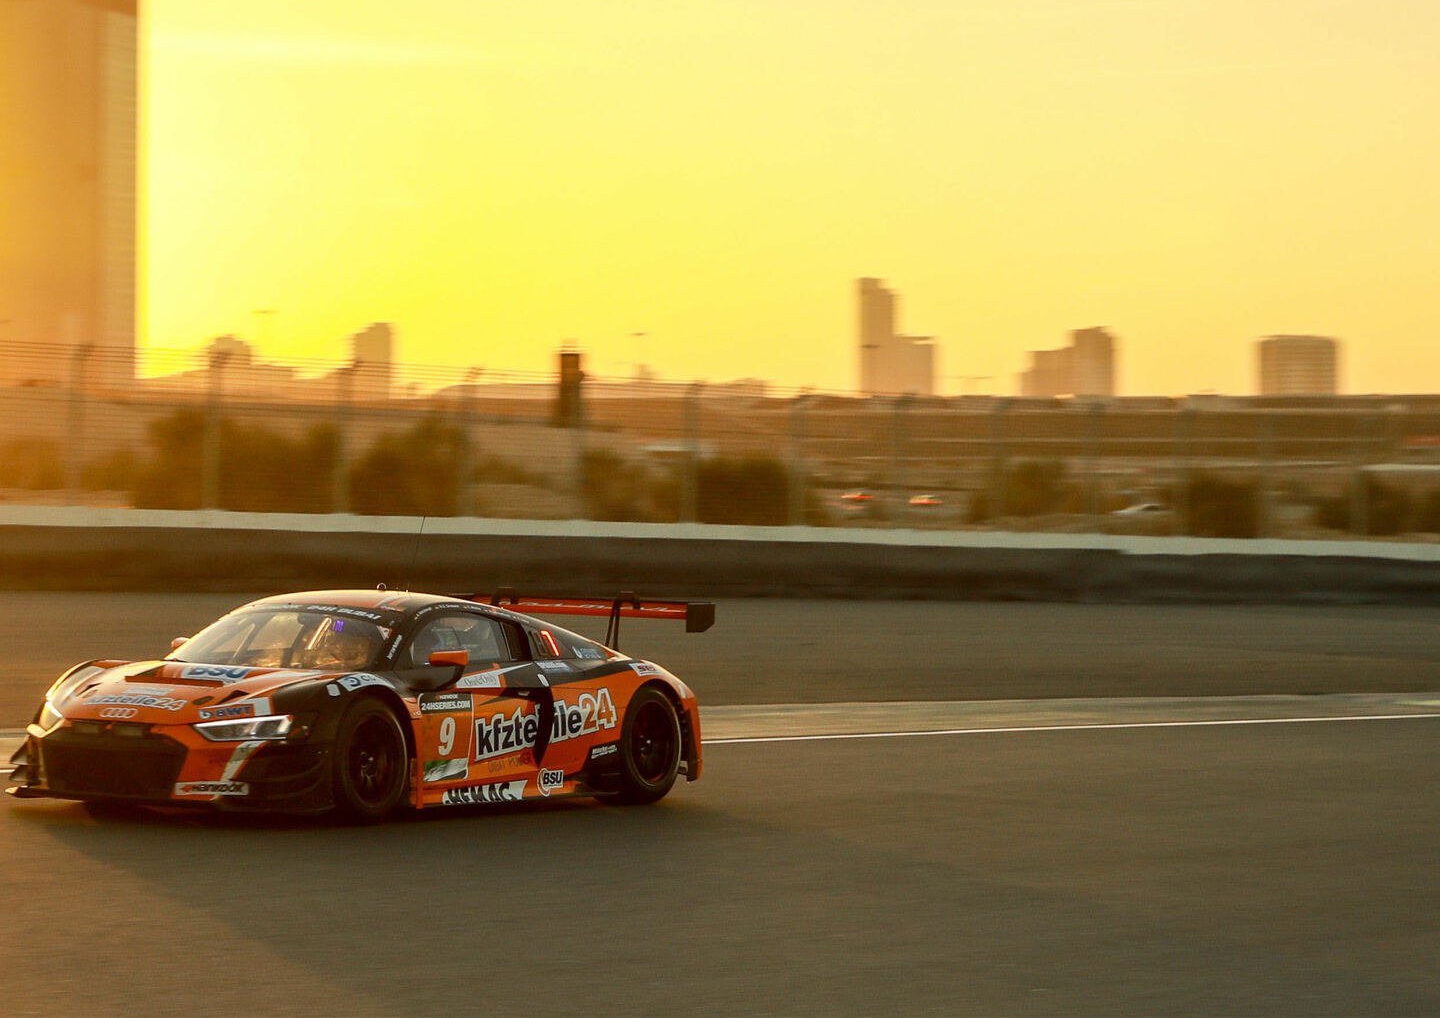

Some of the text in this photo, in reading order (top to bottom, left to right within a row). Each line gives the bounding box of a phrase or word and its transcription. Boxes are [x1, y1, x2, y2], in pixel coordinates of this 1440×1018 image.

[421, 699, 470, 711] 24HSERIES.COM
[438, 716, 456, 756] 9
[543, 771, 563, 784] BSU
